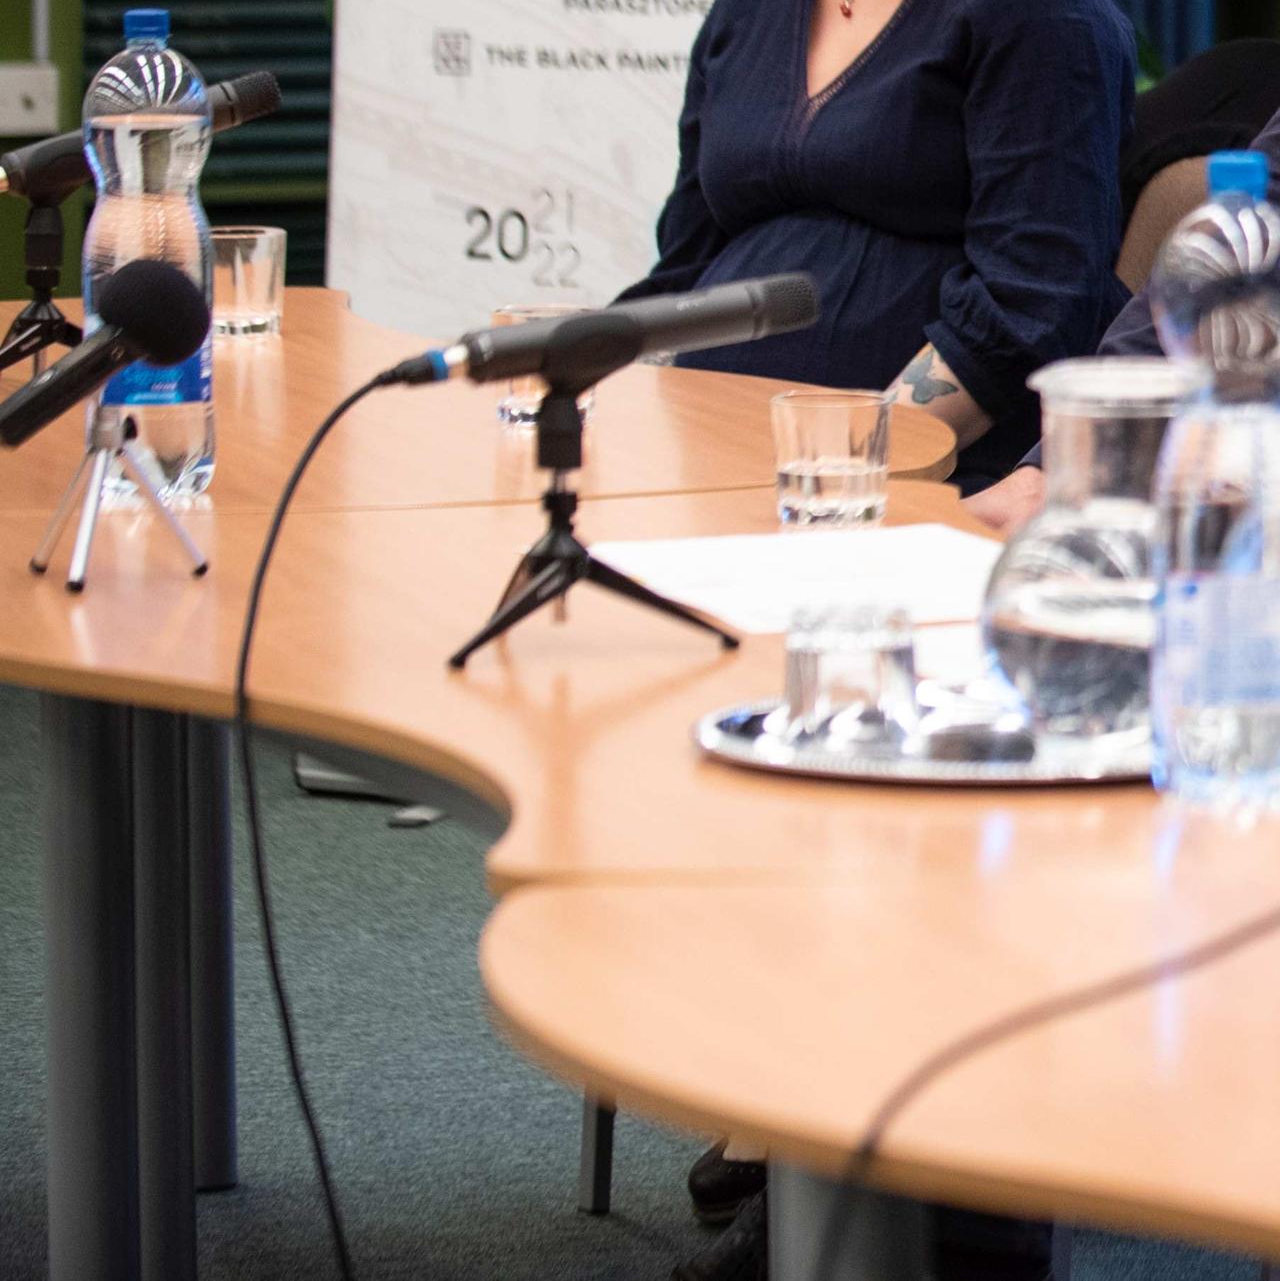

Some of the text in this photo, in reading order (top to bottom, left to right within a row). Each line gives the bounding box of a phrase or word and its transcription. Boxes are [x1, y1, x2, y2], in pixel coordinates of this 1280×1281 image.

[486, 45, 529, 69] THE
[537, 49, 611, 71] BLACK
[466, 207, 530, 264] 20
